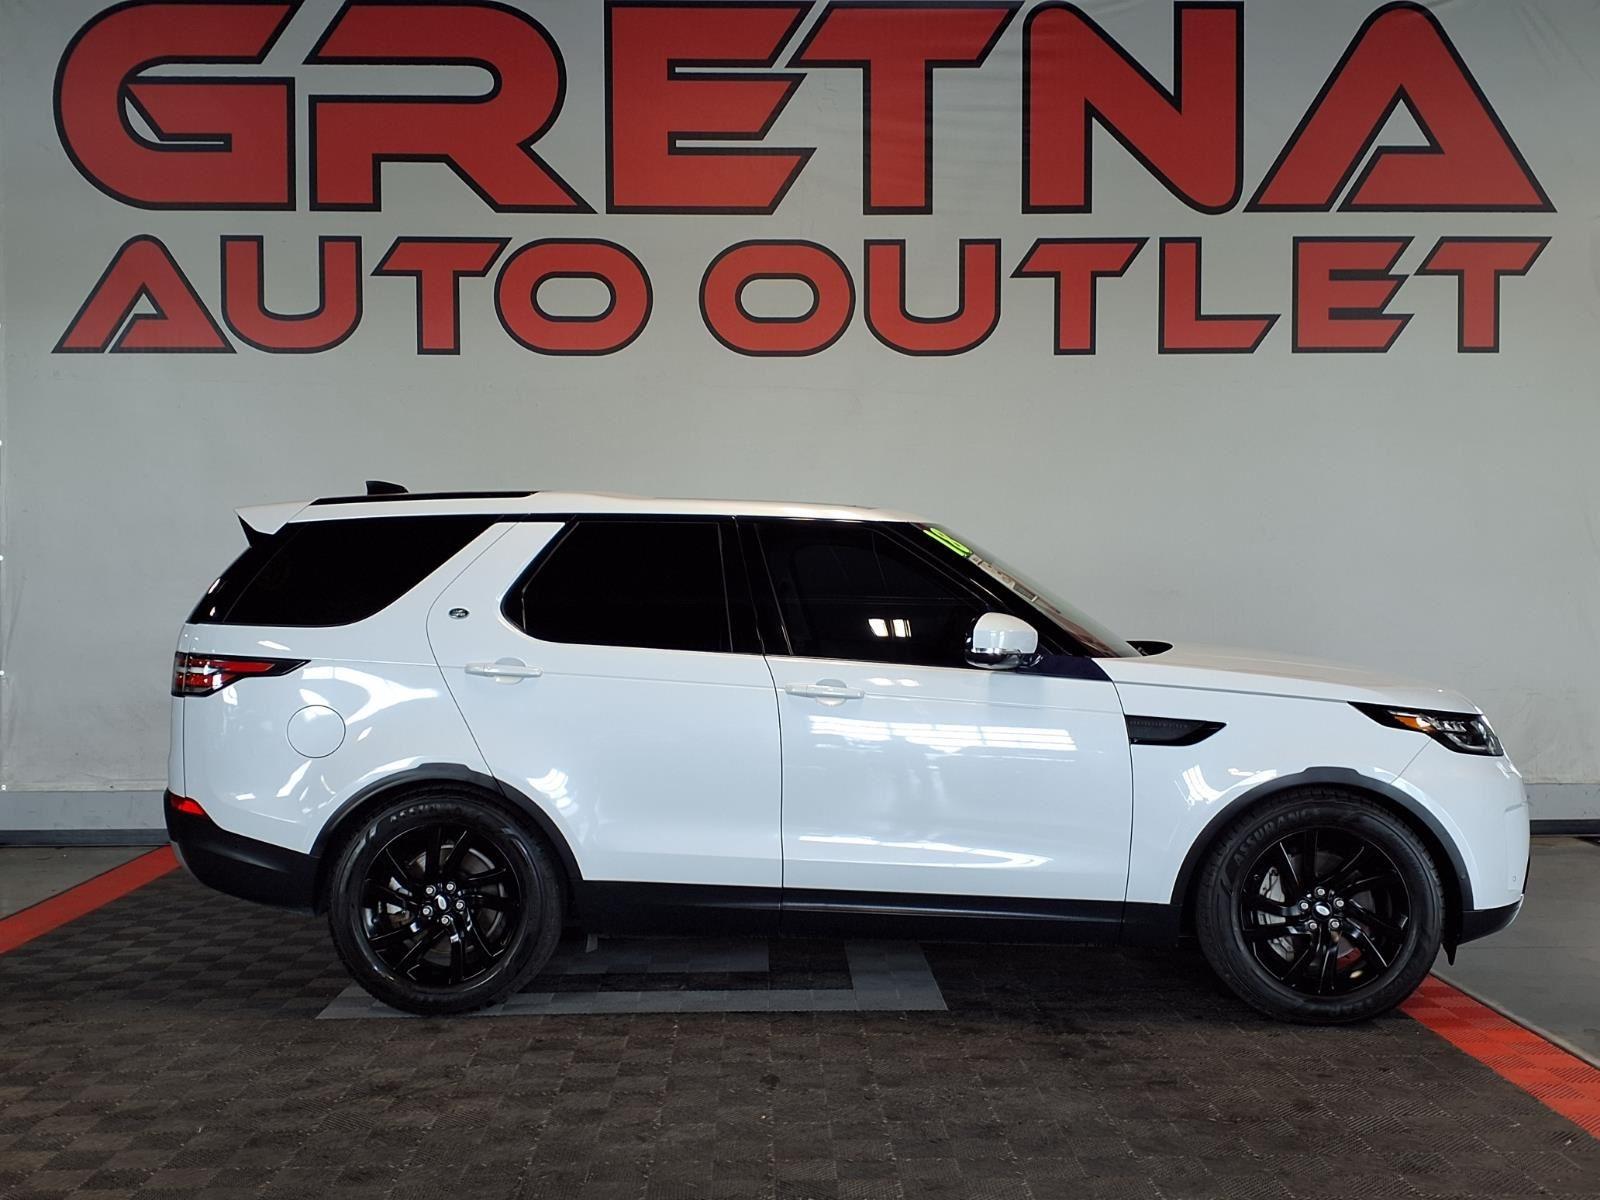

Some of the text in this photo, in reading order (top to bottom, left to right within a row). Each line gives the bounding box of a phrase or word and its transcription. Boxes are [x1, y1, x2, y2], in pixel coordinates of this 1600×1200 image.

[53, 0, 1557, 214] GRETNA
[51, 234, 1552, 357] AUTO OUTLET
